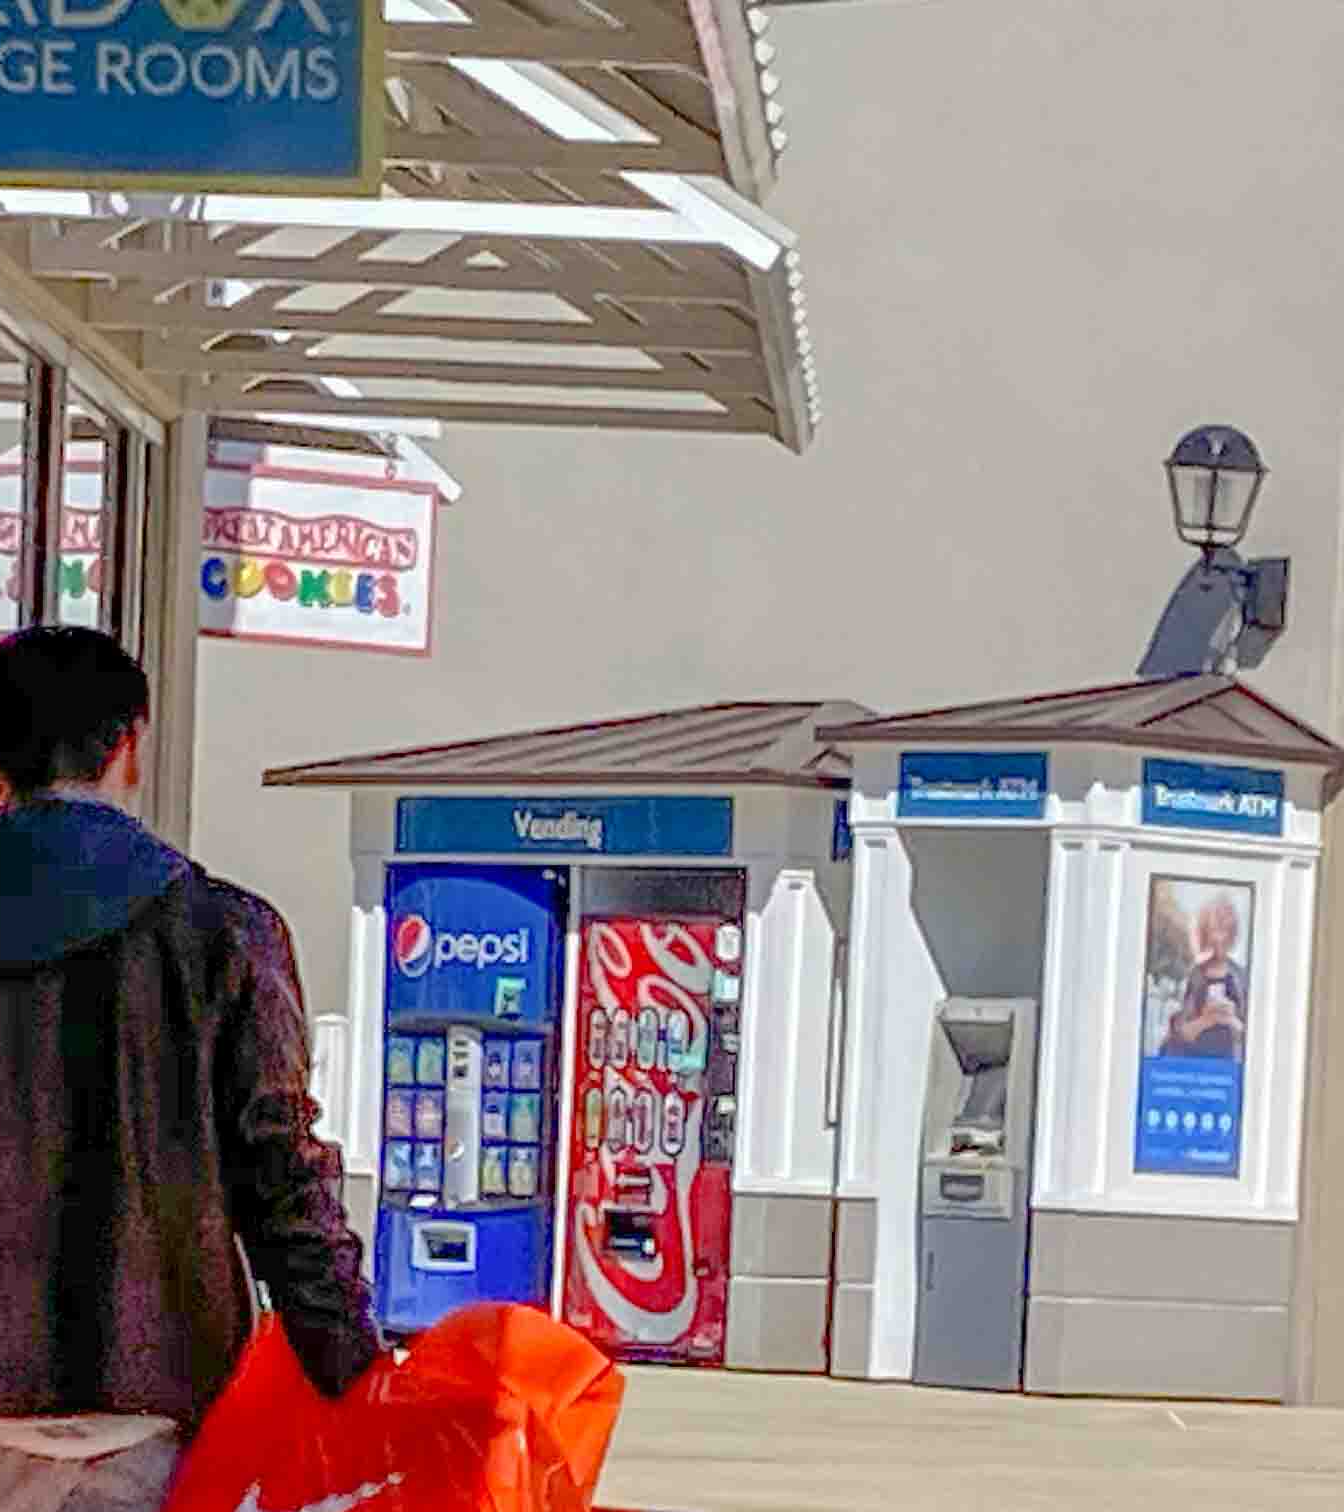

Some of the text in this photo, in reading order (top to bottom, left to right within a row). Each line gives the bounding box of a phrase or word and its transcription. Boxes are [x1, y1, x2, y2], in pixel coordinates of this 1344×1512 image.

[96, 42, 340, 100] ROOMS
[200, 556, 401, 618] COOKIES
[513, 809, 603, 850] Vending
[434, 927, 529, 970] pepsi
